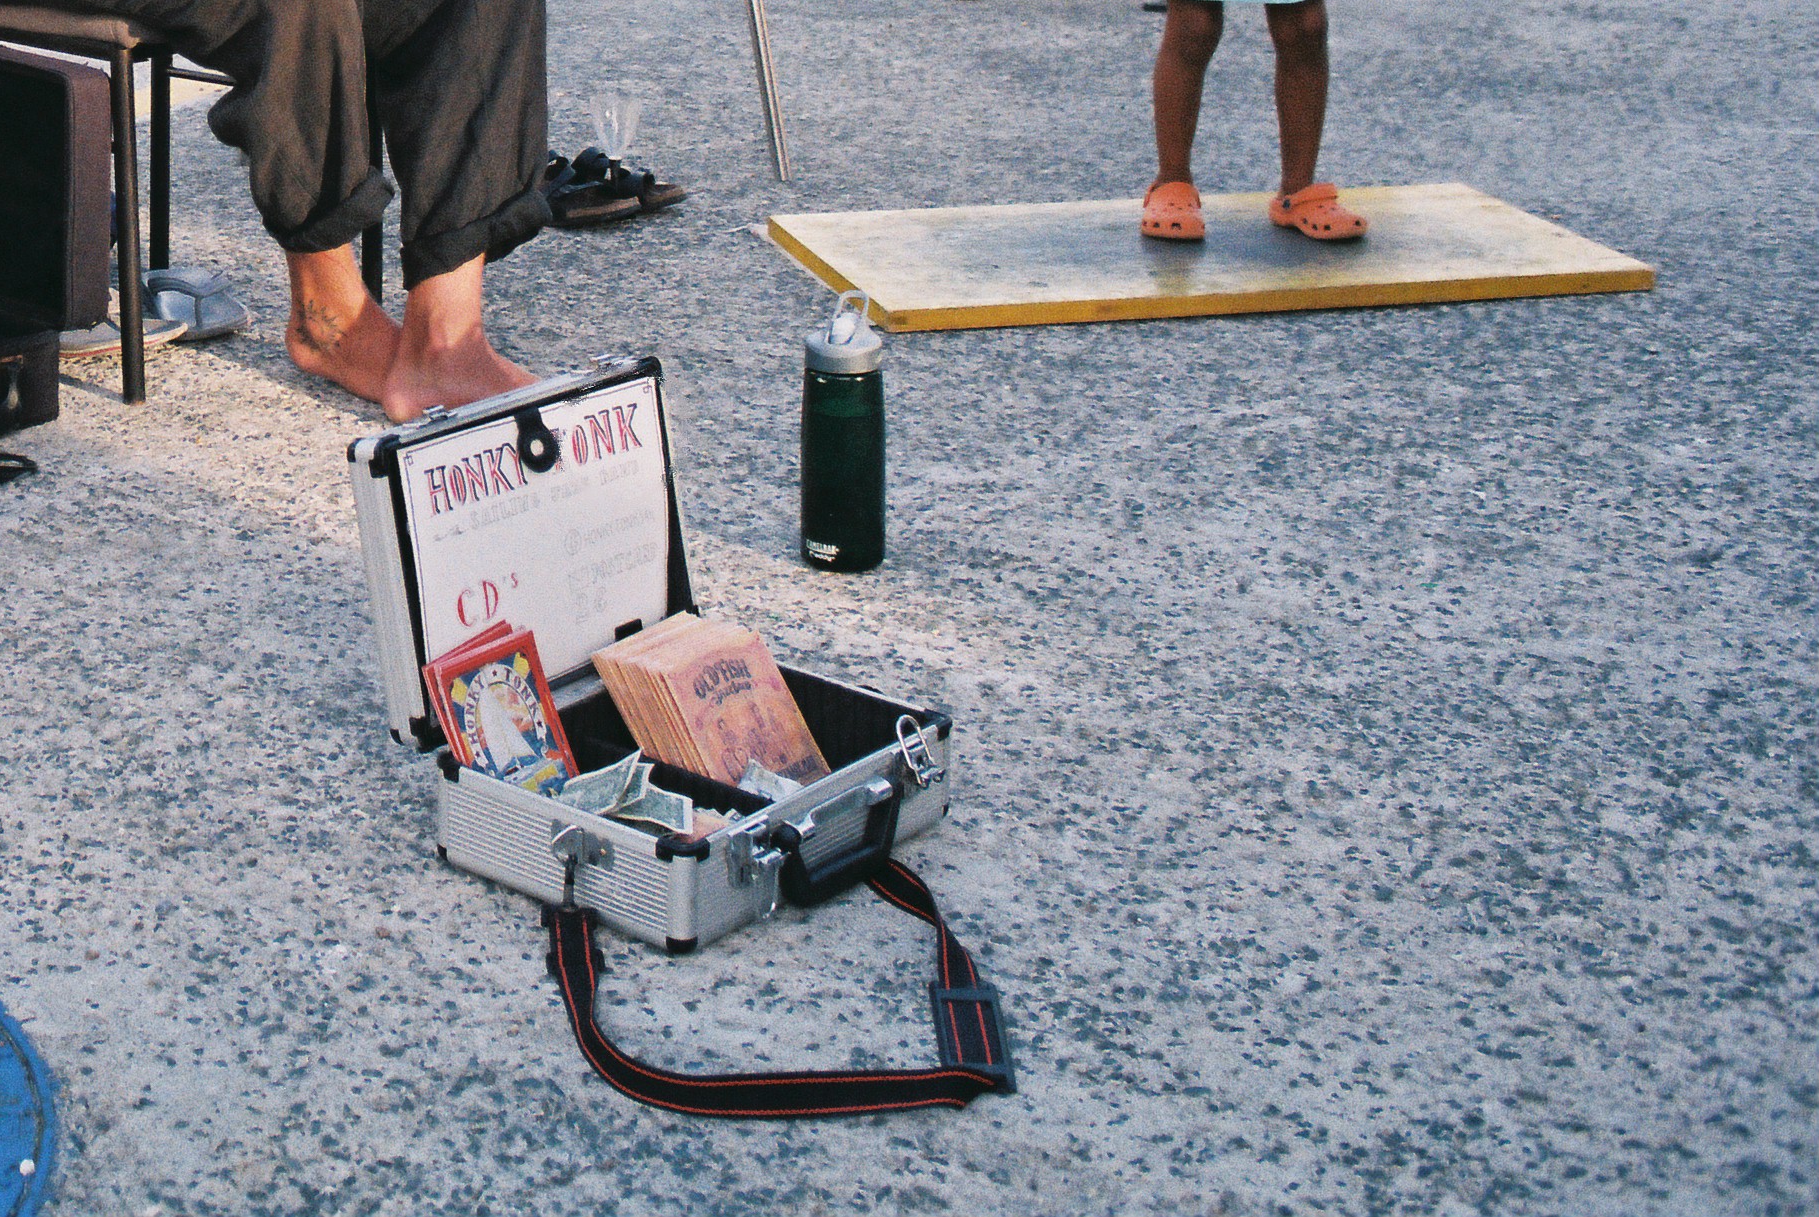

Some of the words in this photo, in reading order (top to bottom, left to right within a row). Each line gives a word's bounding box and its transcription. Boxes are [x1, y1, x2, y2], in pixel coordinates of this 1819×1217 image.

[423, 442, 528, 516] HONKY
[553, 402, 643, 468] ONK
[465, 674, 485, 745] HONKY
[503, 667, 540, 717] TONK
[692, 665, 721, 700] OLD
[713, 658, 752, 683] FISH
